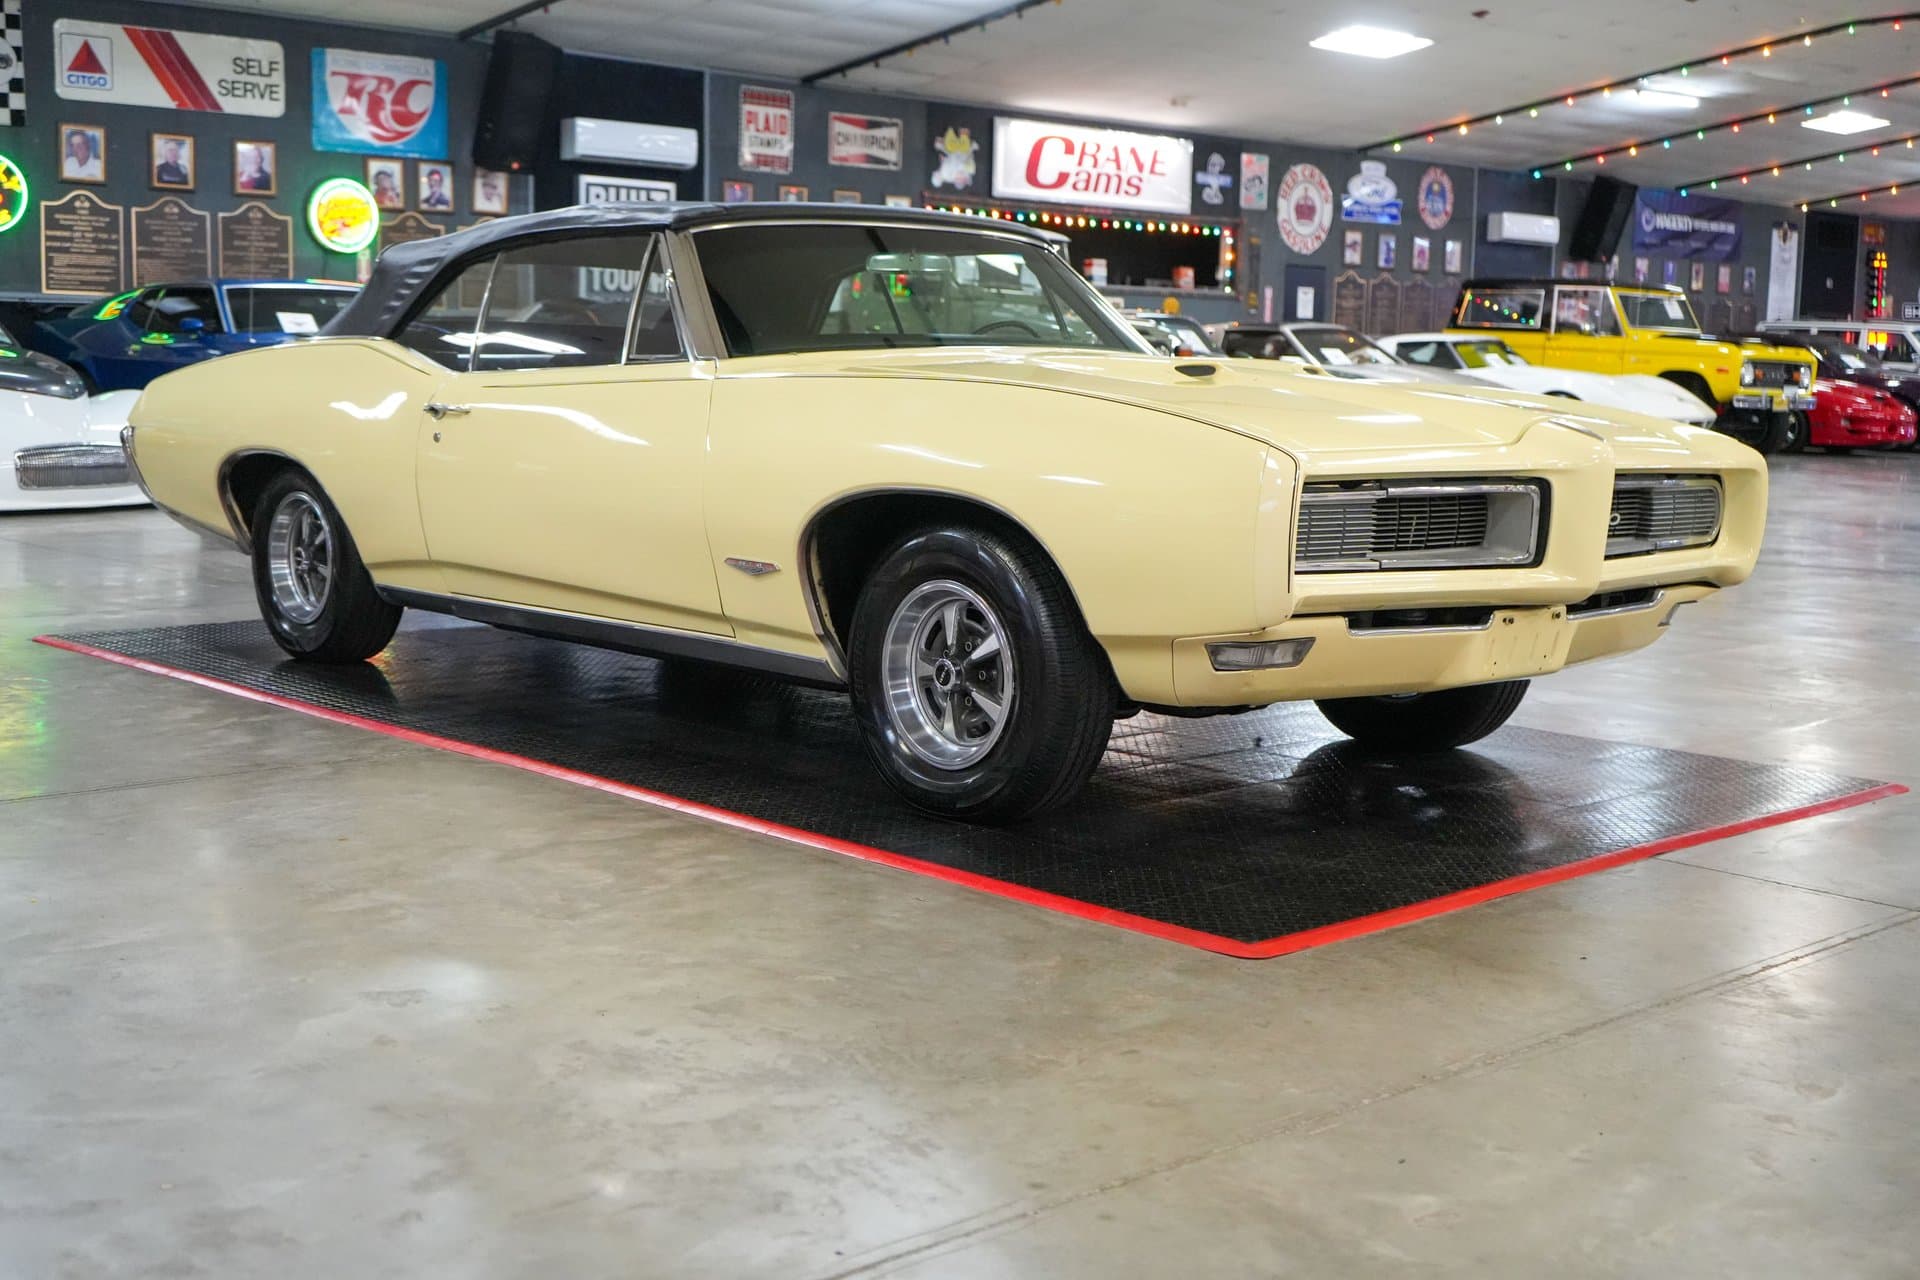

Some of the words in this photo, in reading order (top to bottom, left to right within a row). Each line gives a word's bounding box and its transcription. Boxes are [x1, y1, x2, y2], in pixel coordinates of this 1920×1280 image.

[232, 56, 280, 78] SELF
[67, 74, 107, 87] CITGO
[217, 79, 281, 101] SERVE
[330, 69, 433, 143] RC
[745, 110, 788, 135] PLAID
[749, 135, 786, 150] STAMPS
[836, 130, 897, 151] CHAMPION
[1280, 169, 1298, 199] RED
[1281, 218, 1329, 254] GASOLINE
